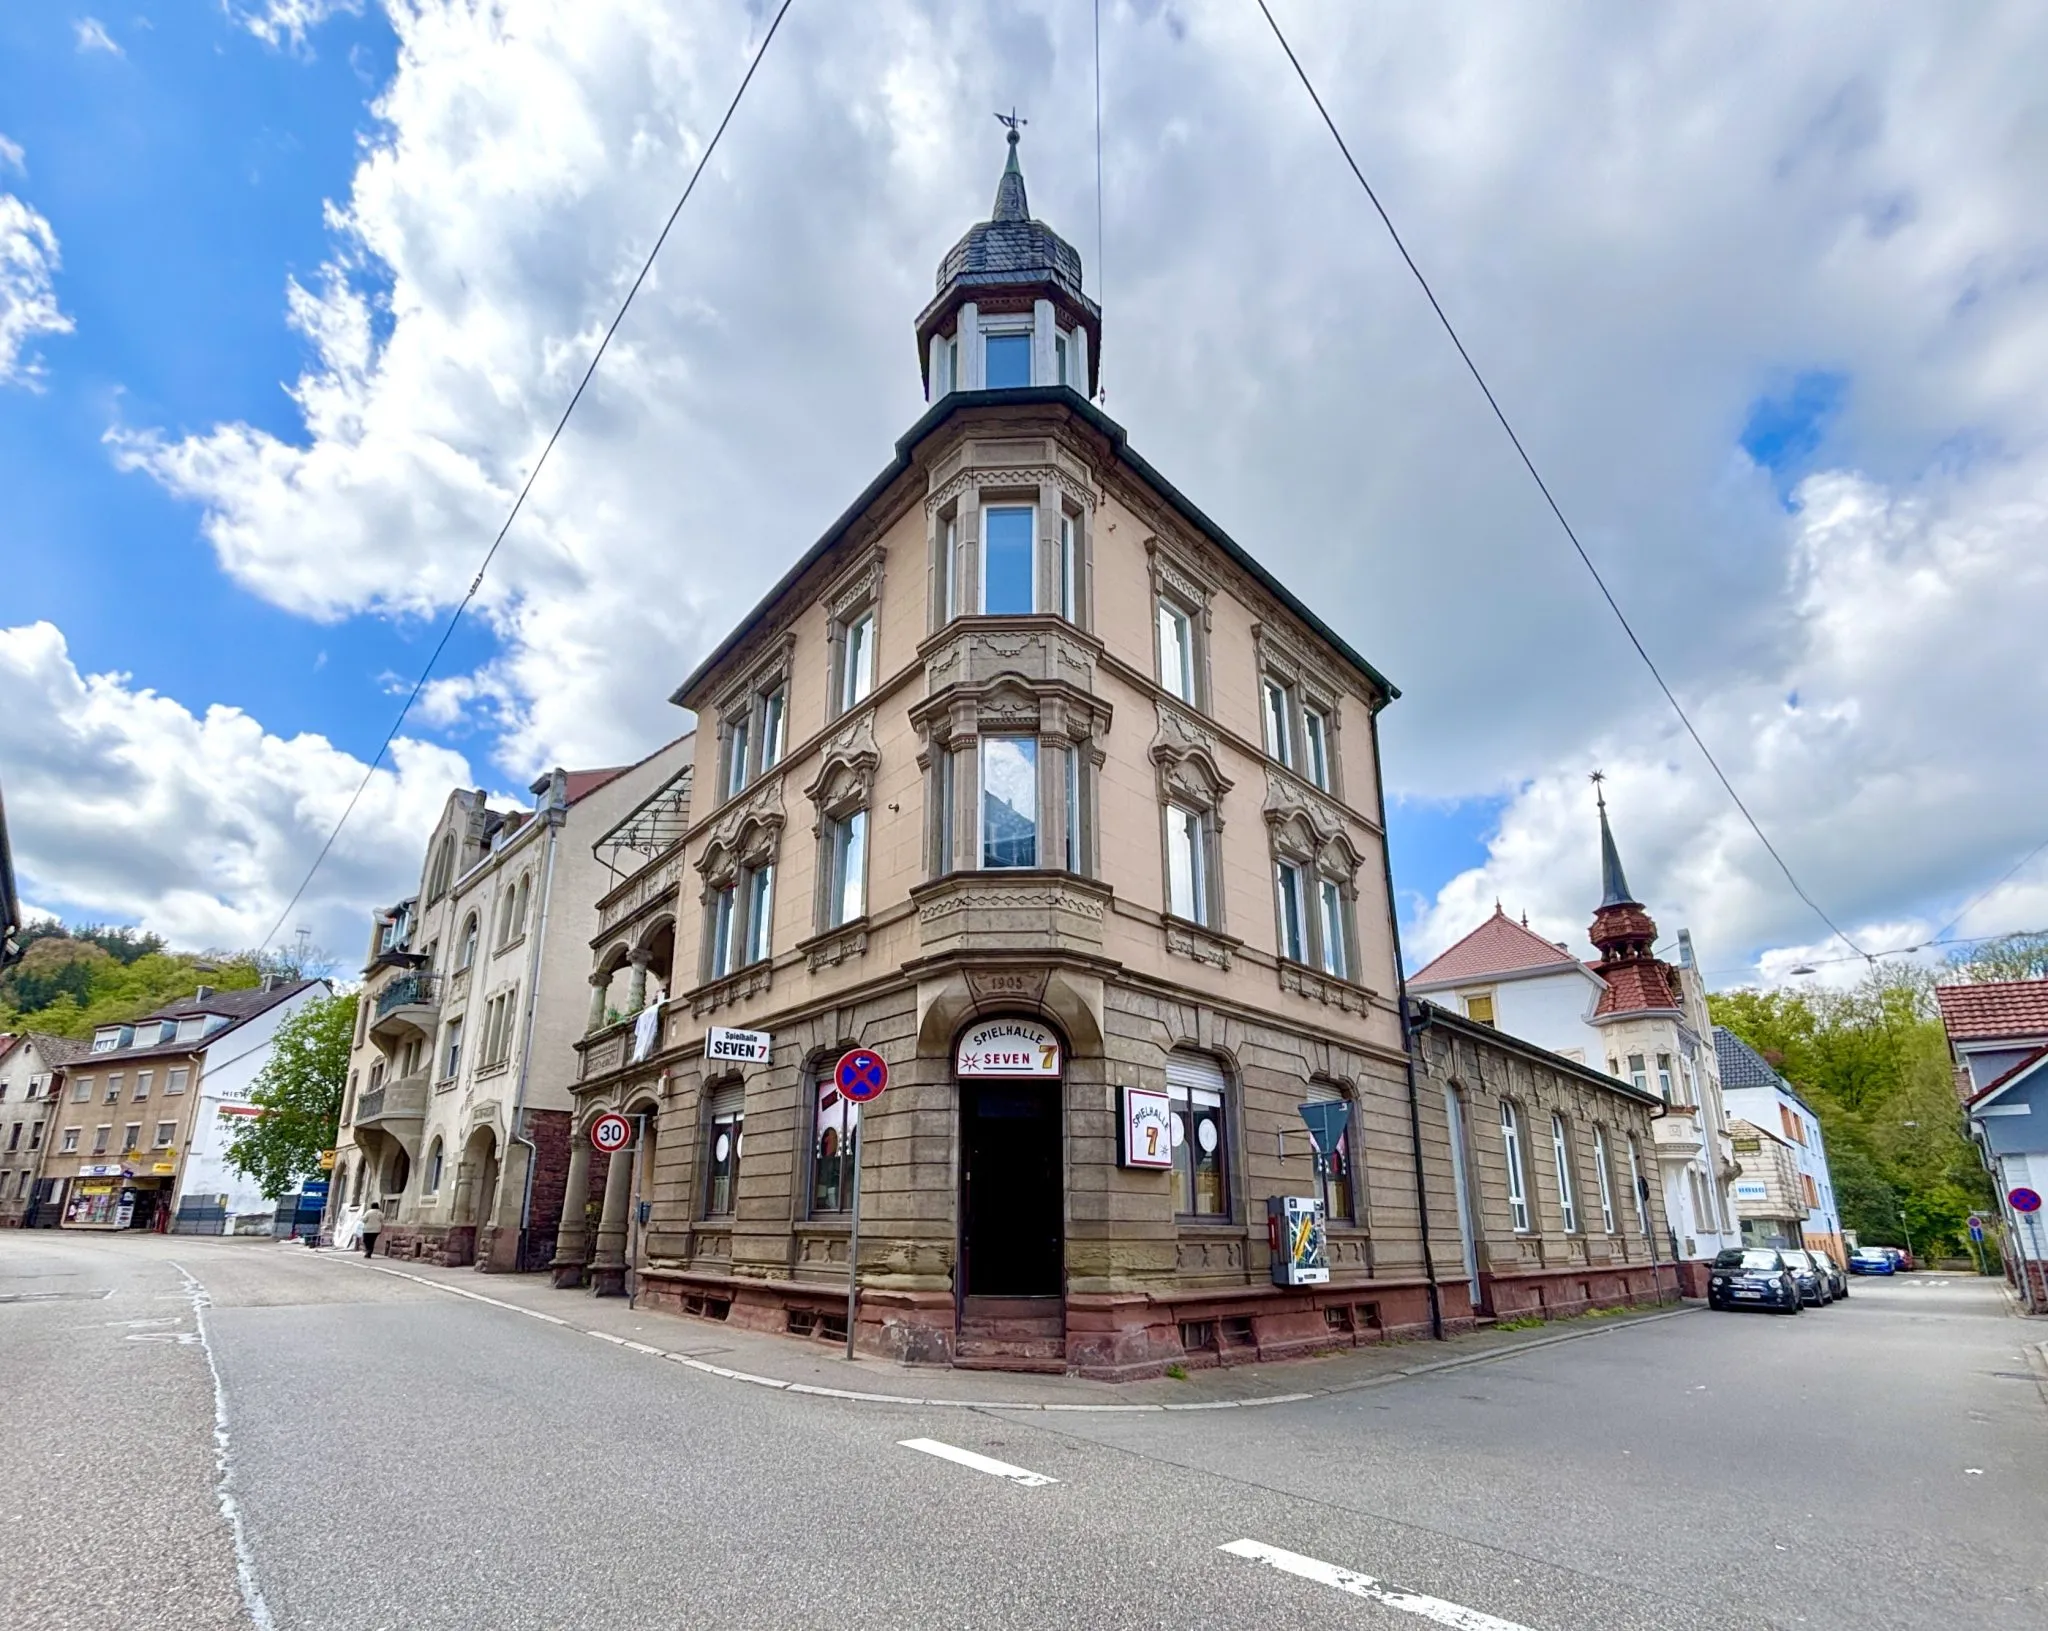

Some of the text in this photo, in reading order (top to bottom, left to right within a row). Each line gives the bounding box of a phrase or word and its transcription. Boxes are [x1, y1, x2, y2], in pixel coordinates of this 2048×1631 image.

[992, 976, 1023, 990] 1905
[725, 1031, 758, 1042] Spielhalle
[973, 1025, 1045, 1046] SPIELHALLE
[714, 1041, 767, 1059] SEVEN 7
[984, 1045, 1058, 1069] SEVEN 7
[1132, 1106, 1169, 1131] SPIELHALLE
[600, 1124, 622, 1141] 30
[1146, 1126, 1158, 1156] 7
